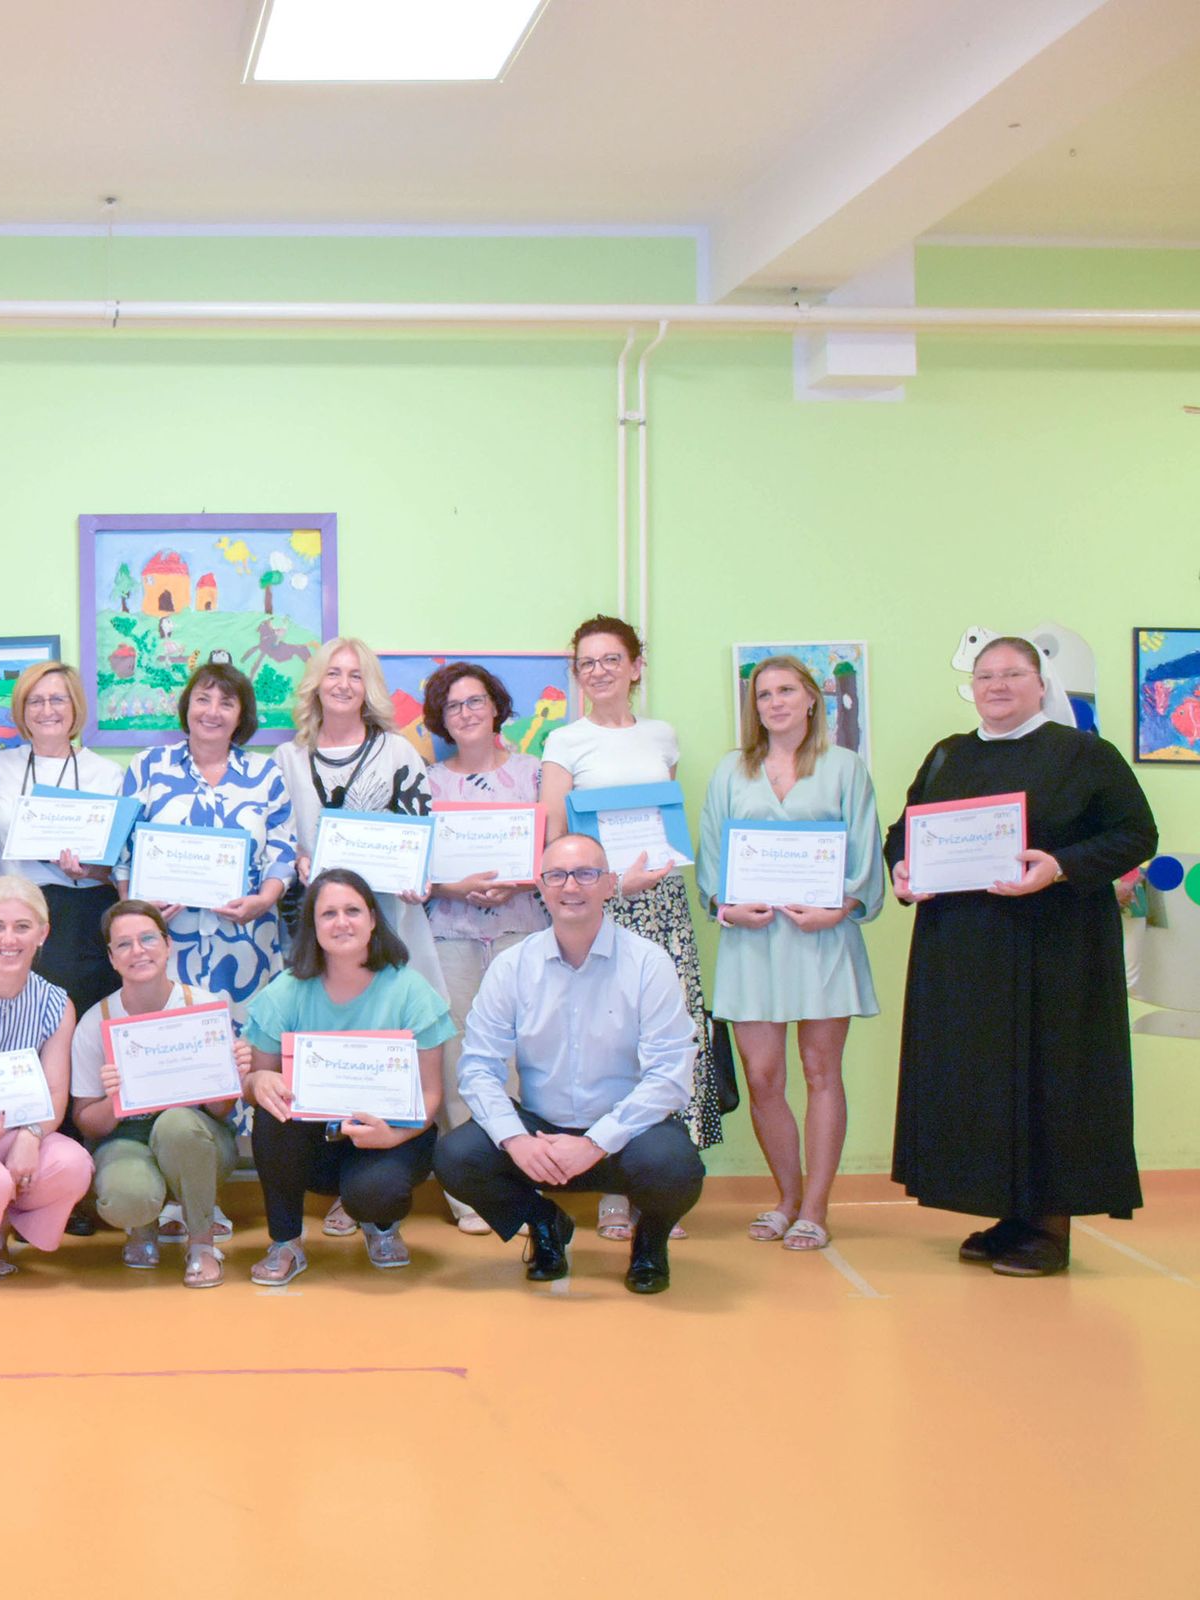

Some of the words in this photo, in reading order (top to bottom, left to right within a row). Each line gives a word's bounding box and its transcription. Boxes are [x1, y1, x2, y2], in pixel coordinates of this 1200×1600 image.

[40, 812, 82, 824] Diploma
[607, 814, 650, 827] Diploma
[167, 849, 211, 862] Diploma
[761, 848, 808, 860] Diploma
